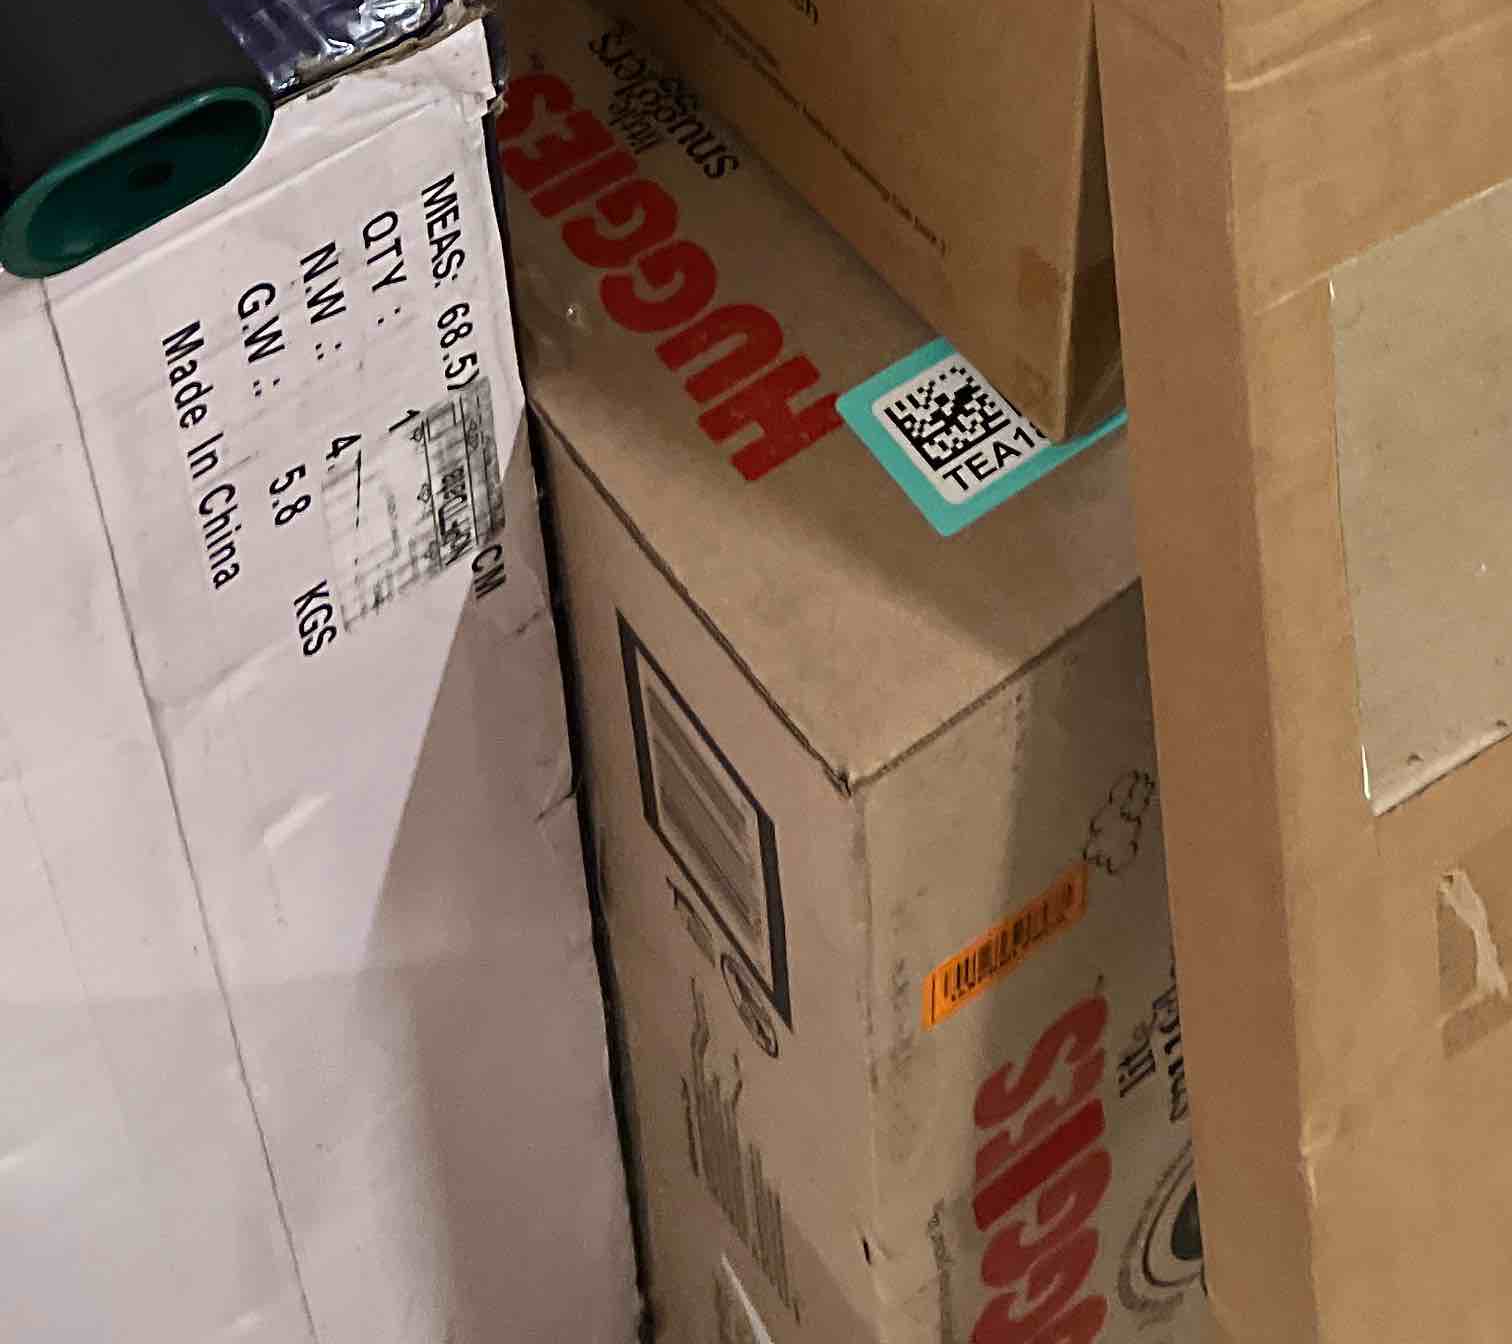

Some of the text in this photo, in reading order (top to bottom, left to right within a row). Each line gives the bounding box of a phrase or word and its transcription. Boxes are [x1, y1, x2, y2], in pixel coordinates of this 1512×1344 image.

[362, 210, 408, 293] QTY
[420, 173, 467, 289] MEAS:
[470, 543, 507, 600] CM
[497, 73, 843, 480] HUGGIES
[162, 320, 241, 592] Made In China
[269, 461, 313, 528] 5.8
[293, 578, 338, 657] KGS
